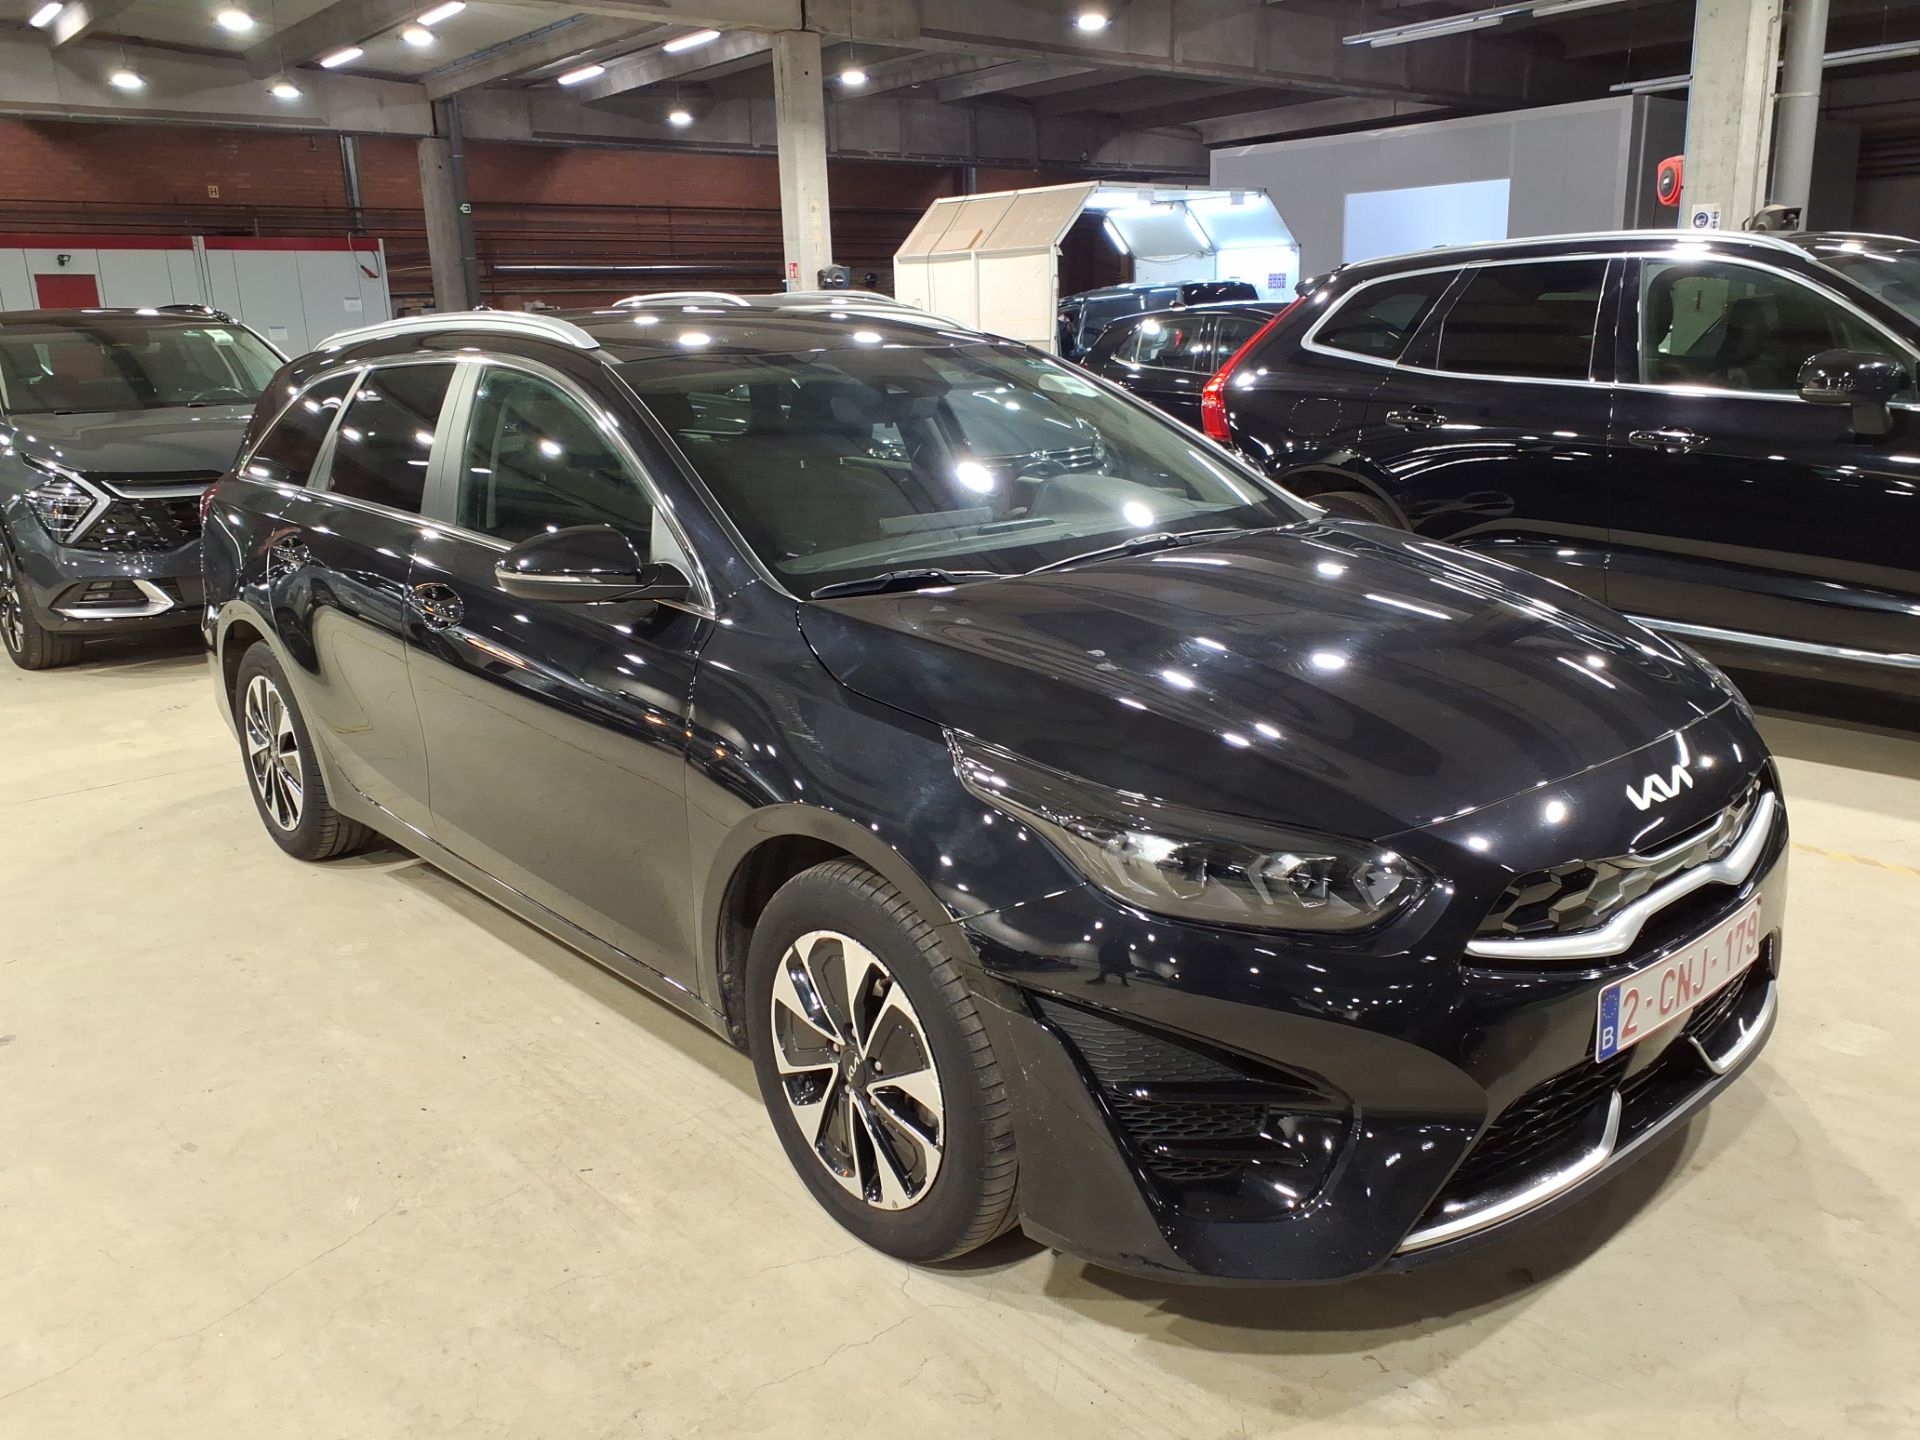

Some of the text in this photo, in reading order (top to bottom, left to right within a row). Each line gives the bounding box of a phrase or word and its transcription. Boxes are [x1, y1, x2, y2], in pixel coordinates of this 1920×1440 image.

[1626, 764, 1693, 811] KIA
[1621, 910, 1757, 1038] 2-CNJ-179
[1602, 1026, 1614, 1050] B
